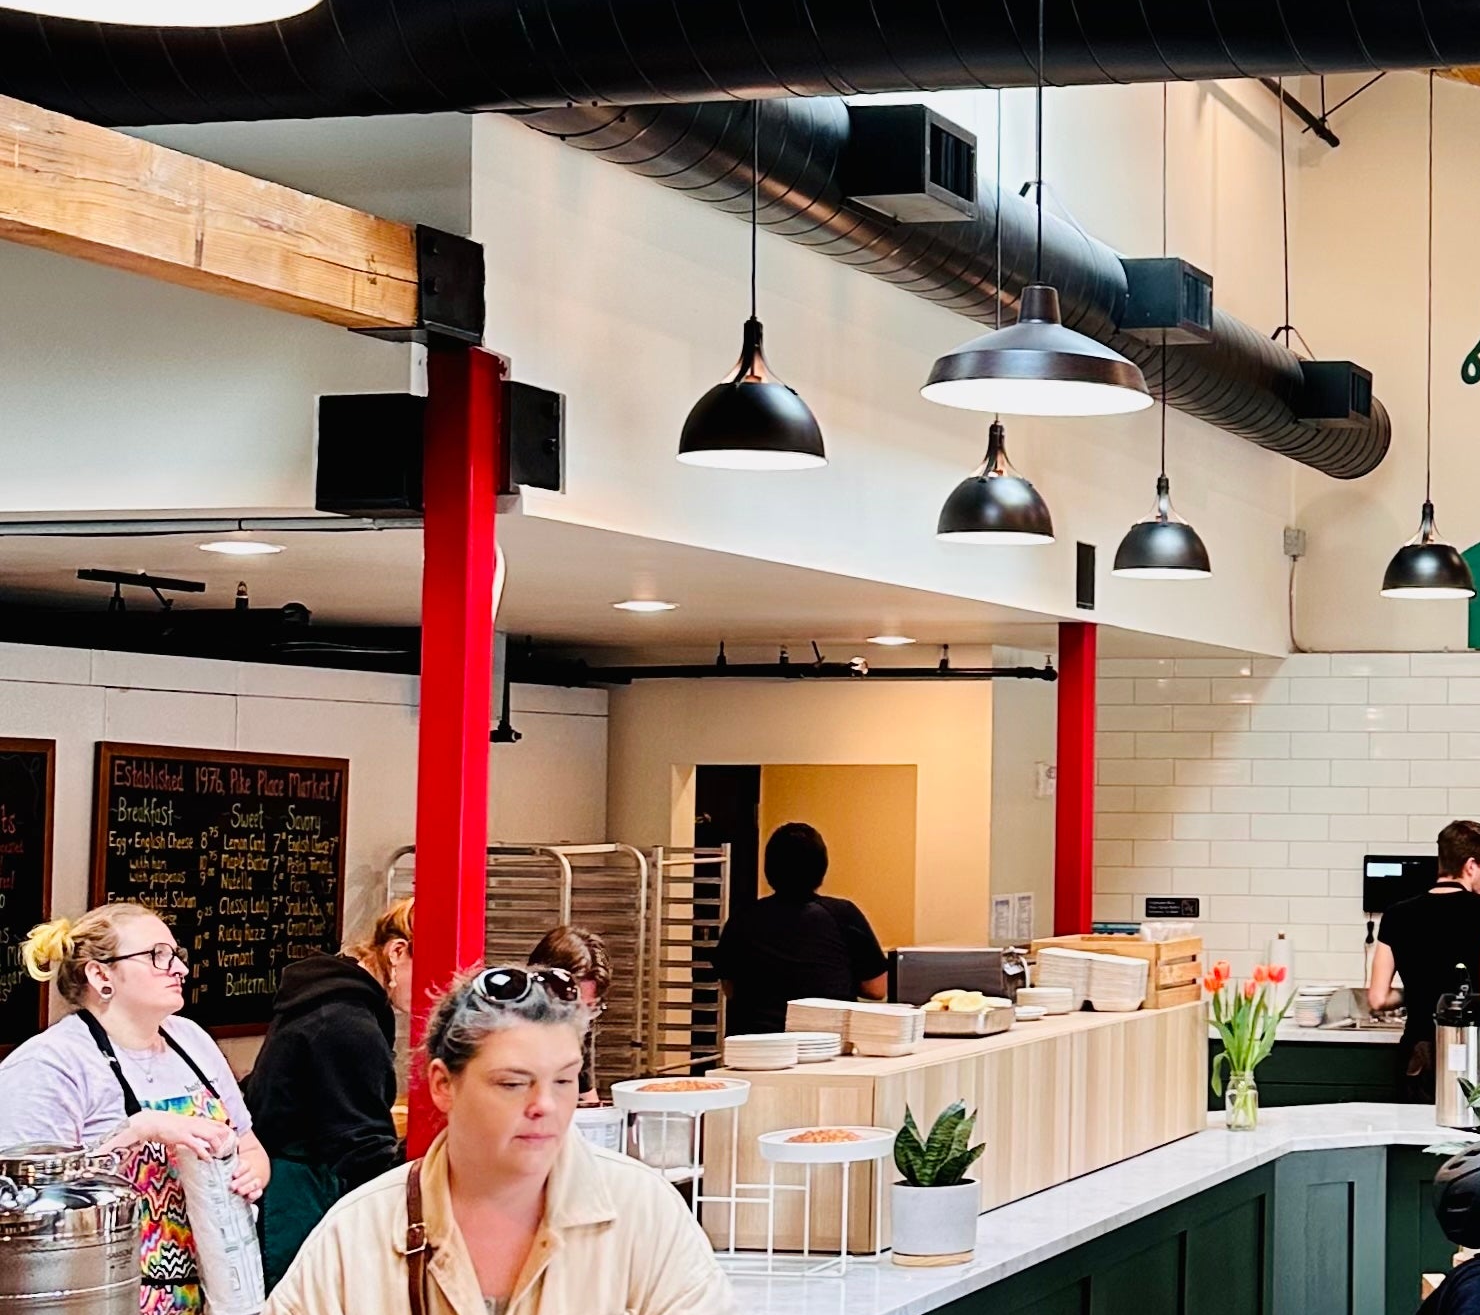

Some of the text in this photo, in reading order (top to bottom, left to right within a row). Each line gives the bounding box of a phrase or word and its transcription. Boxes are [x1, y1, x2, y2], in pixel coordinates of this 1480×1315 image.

[114, 759, 184, 791] Established
[118, 796, 174, 827] Breakfast
[230, 803, 264, 830] Sweet
